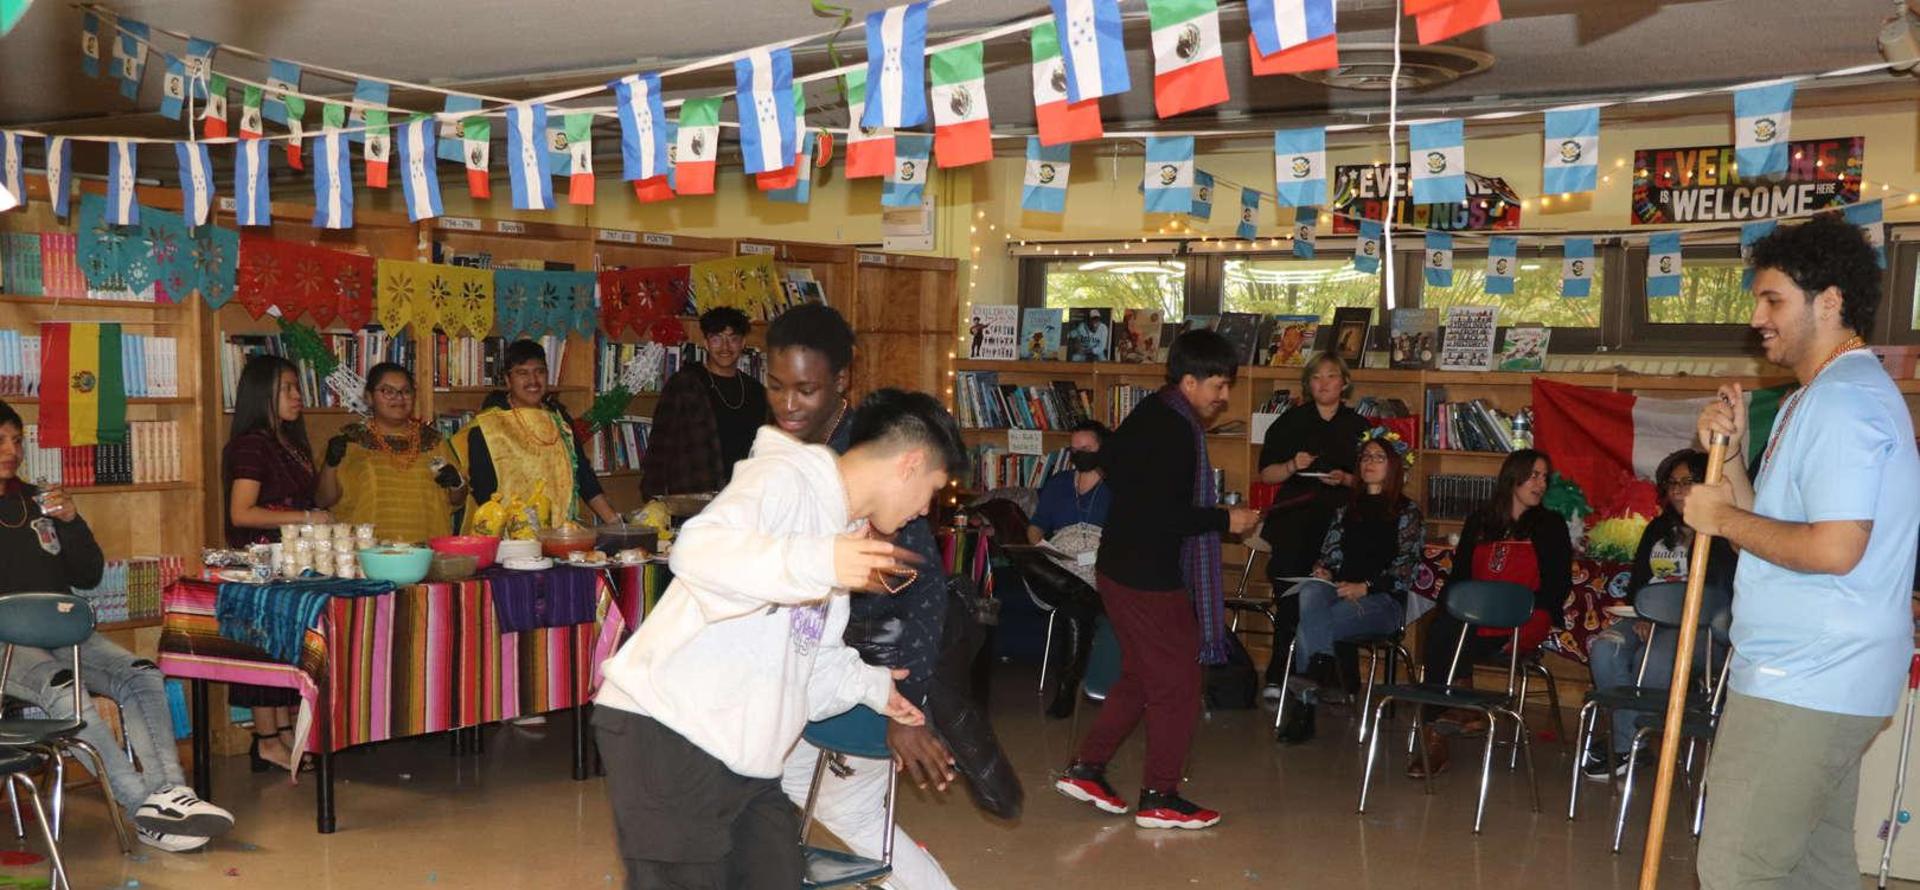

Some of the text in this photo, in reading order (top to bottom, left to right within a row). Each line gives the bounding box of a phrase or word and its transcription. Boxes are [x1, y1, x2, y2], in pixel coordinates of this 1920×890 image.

[1360, 167, 1493, 198] EVENE
[1655, 142, 1840, 188] EVERNE
[1660, 183, 1836, 222] IS WELCOME HERE
